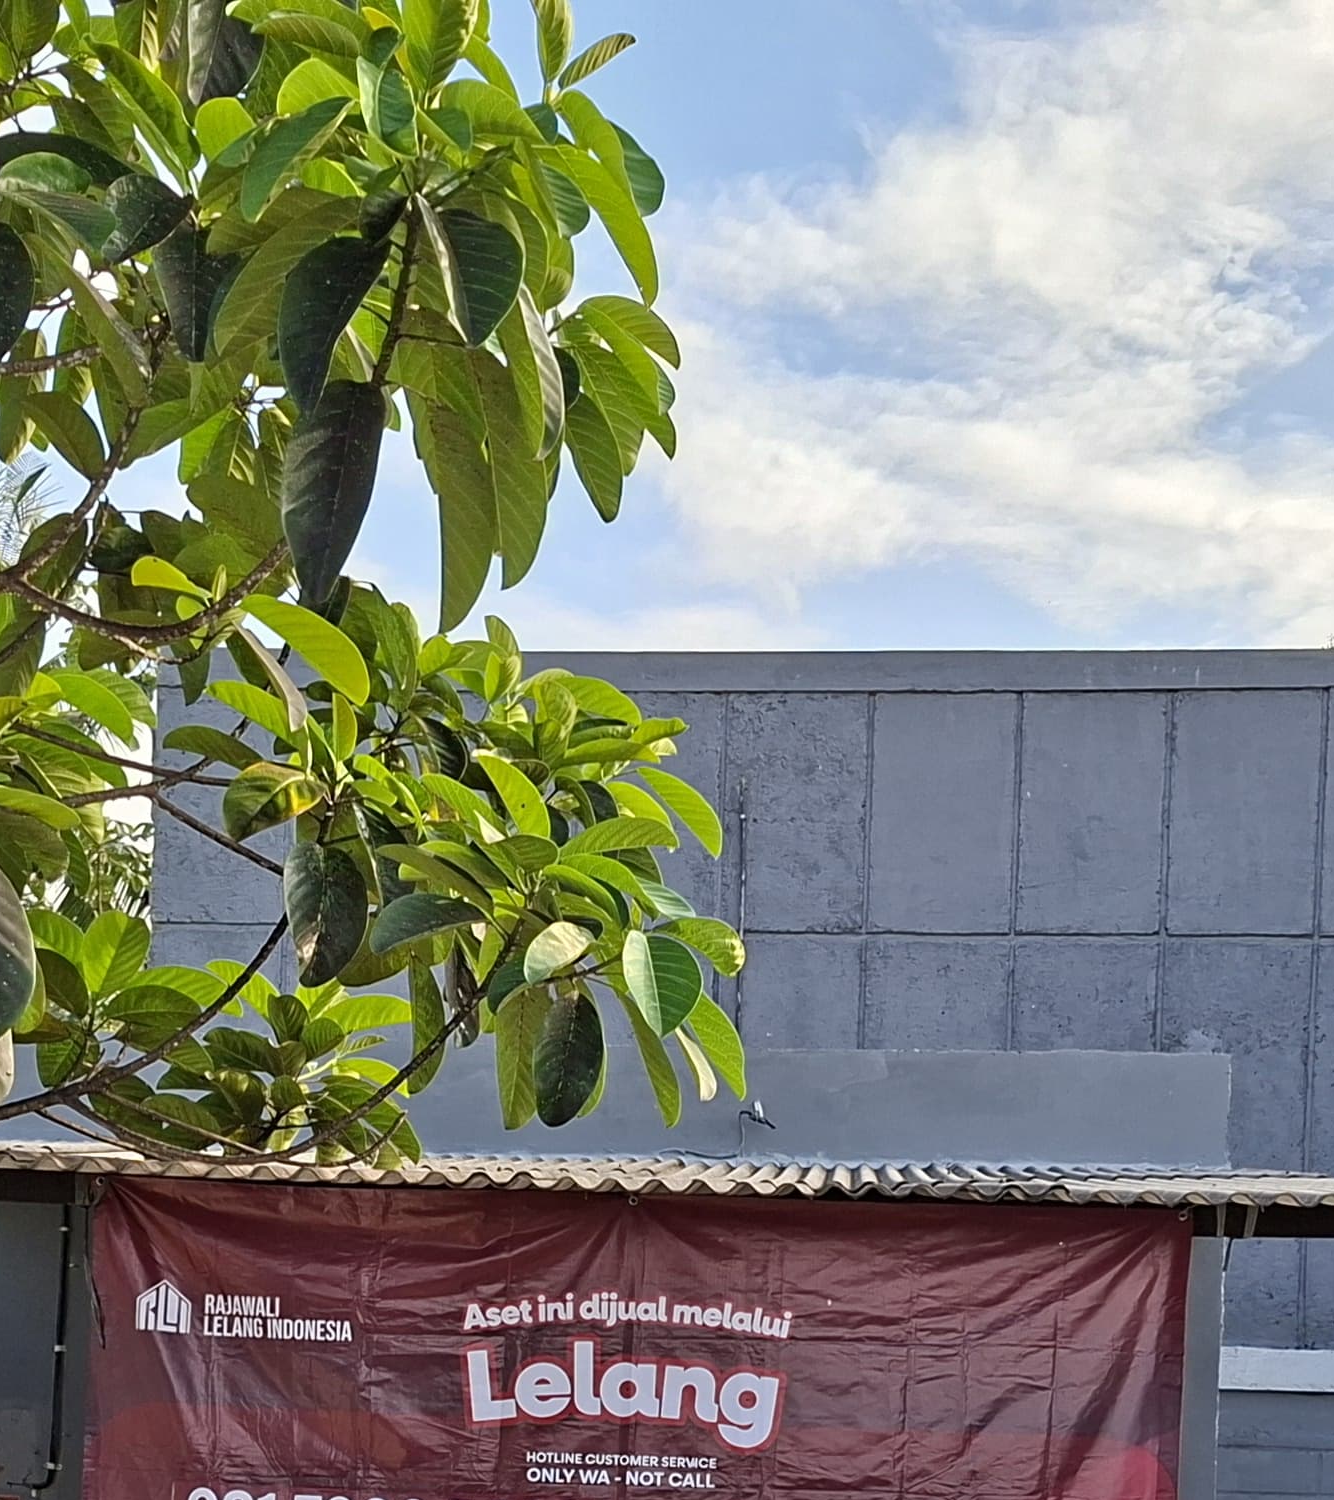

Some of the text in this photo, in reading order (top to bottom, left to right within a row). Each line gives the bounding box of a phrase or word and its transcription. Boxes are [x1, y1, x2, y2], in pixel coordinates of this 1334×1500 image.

[204, 1294, 280, 1317] RAJAWALI
[464, 1292, 793, 1339] Aset ini dijual melalui
[203, 1316, 353, 1342] LELANG INDONESIA
[466, 1340, 780, 1449] Lelang
[526, 1450, 717, 1470] HOTLINE CUSTOMER SERVICE
[526, 1467, 576, 1484] ONLY
[578, 1469, 611, 1485] WA
[625, 1471, 665, 1487] NOT
[667, 1472, 716, 1489] CALL
